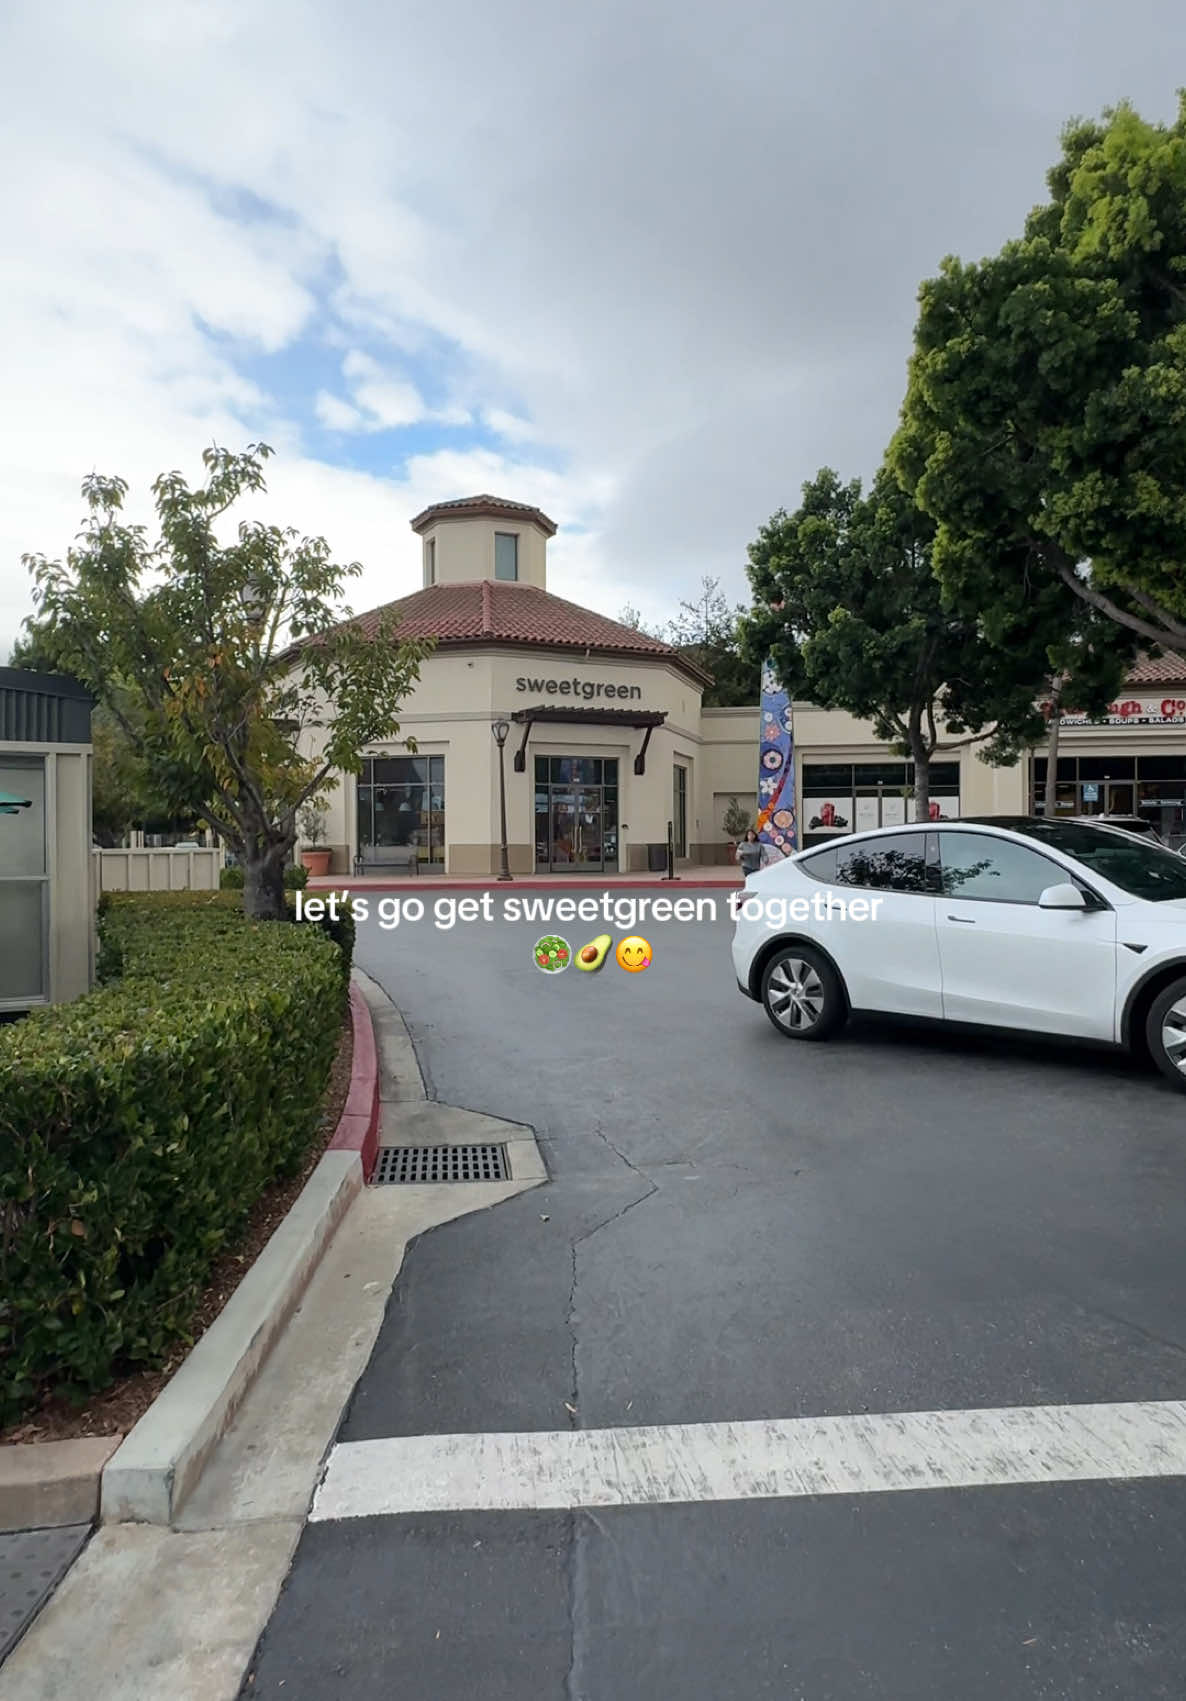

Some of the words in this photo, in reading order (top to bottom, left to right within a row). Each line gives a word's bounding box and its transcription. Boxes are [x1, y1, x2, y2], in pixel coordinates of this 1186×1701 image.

[515, 677, 642, 699] sweetgreen
[1109, 717, 1140, 725] SOUPS
[1148, 716, 1186, 725] SALADS
